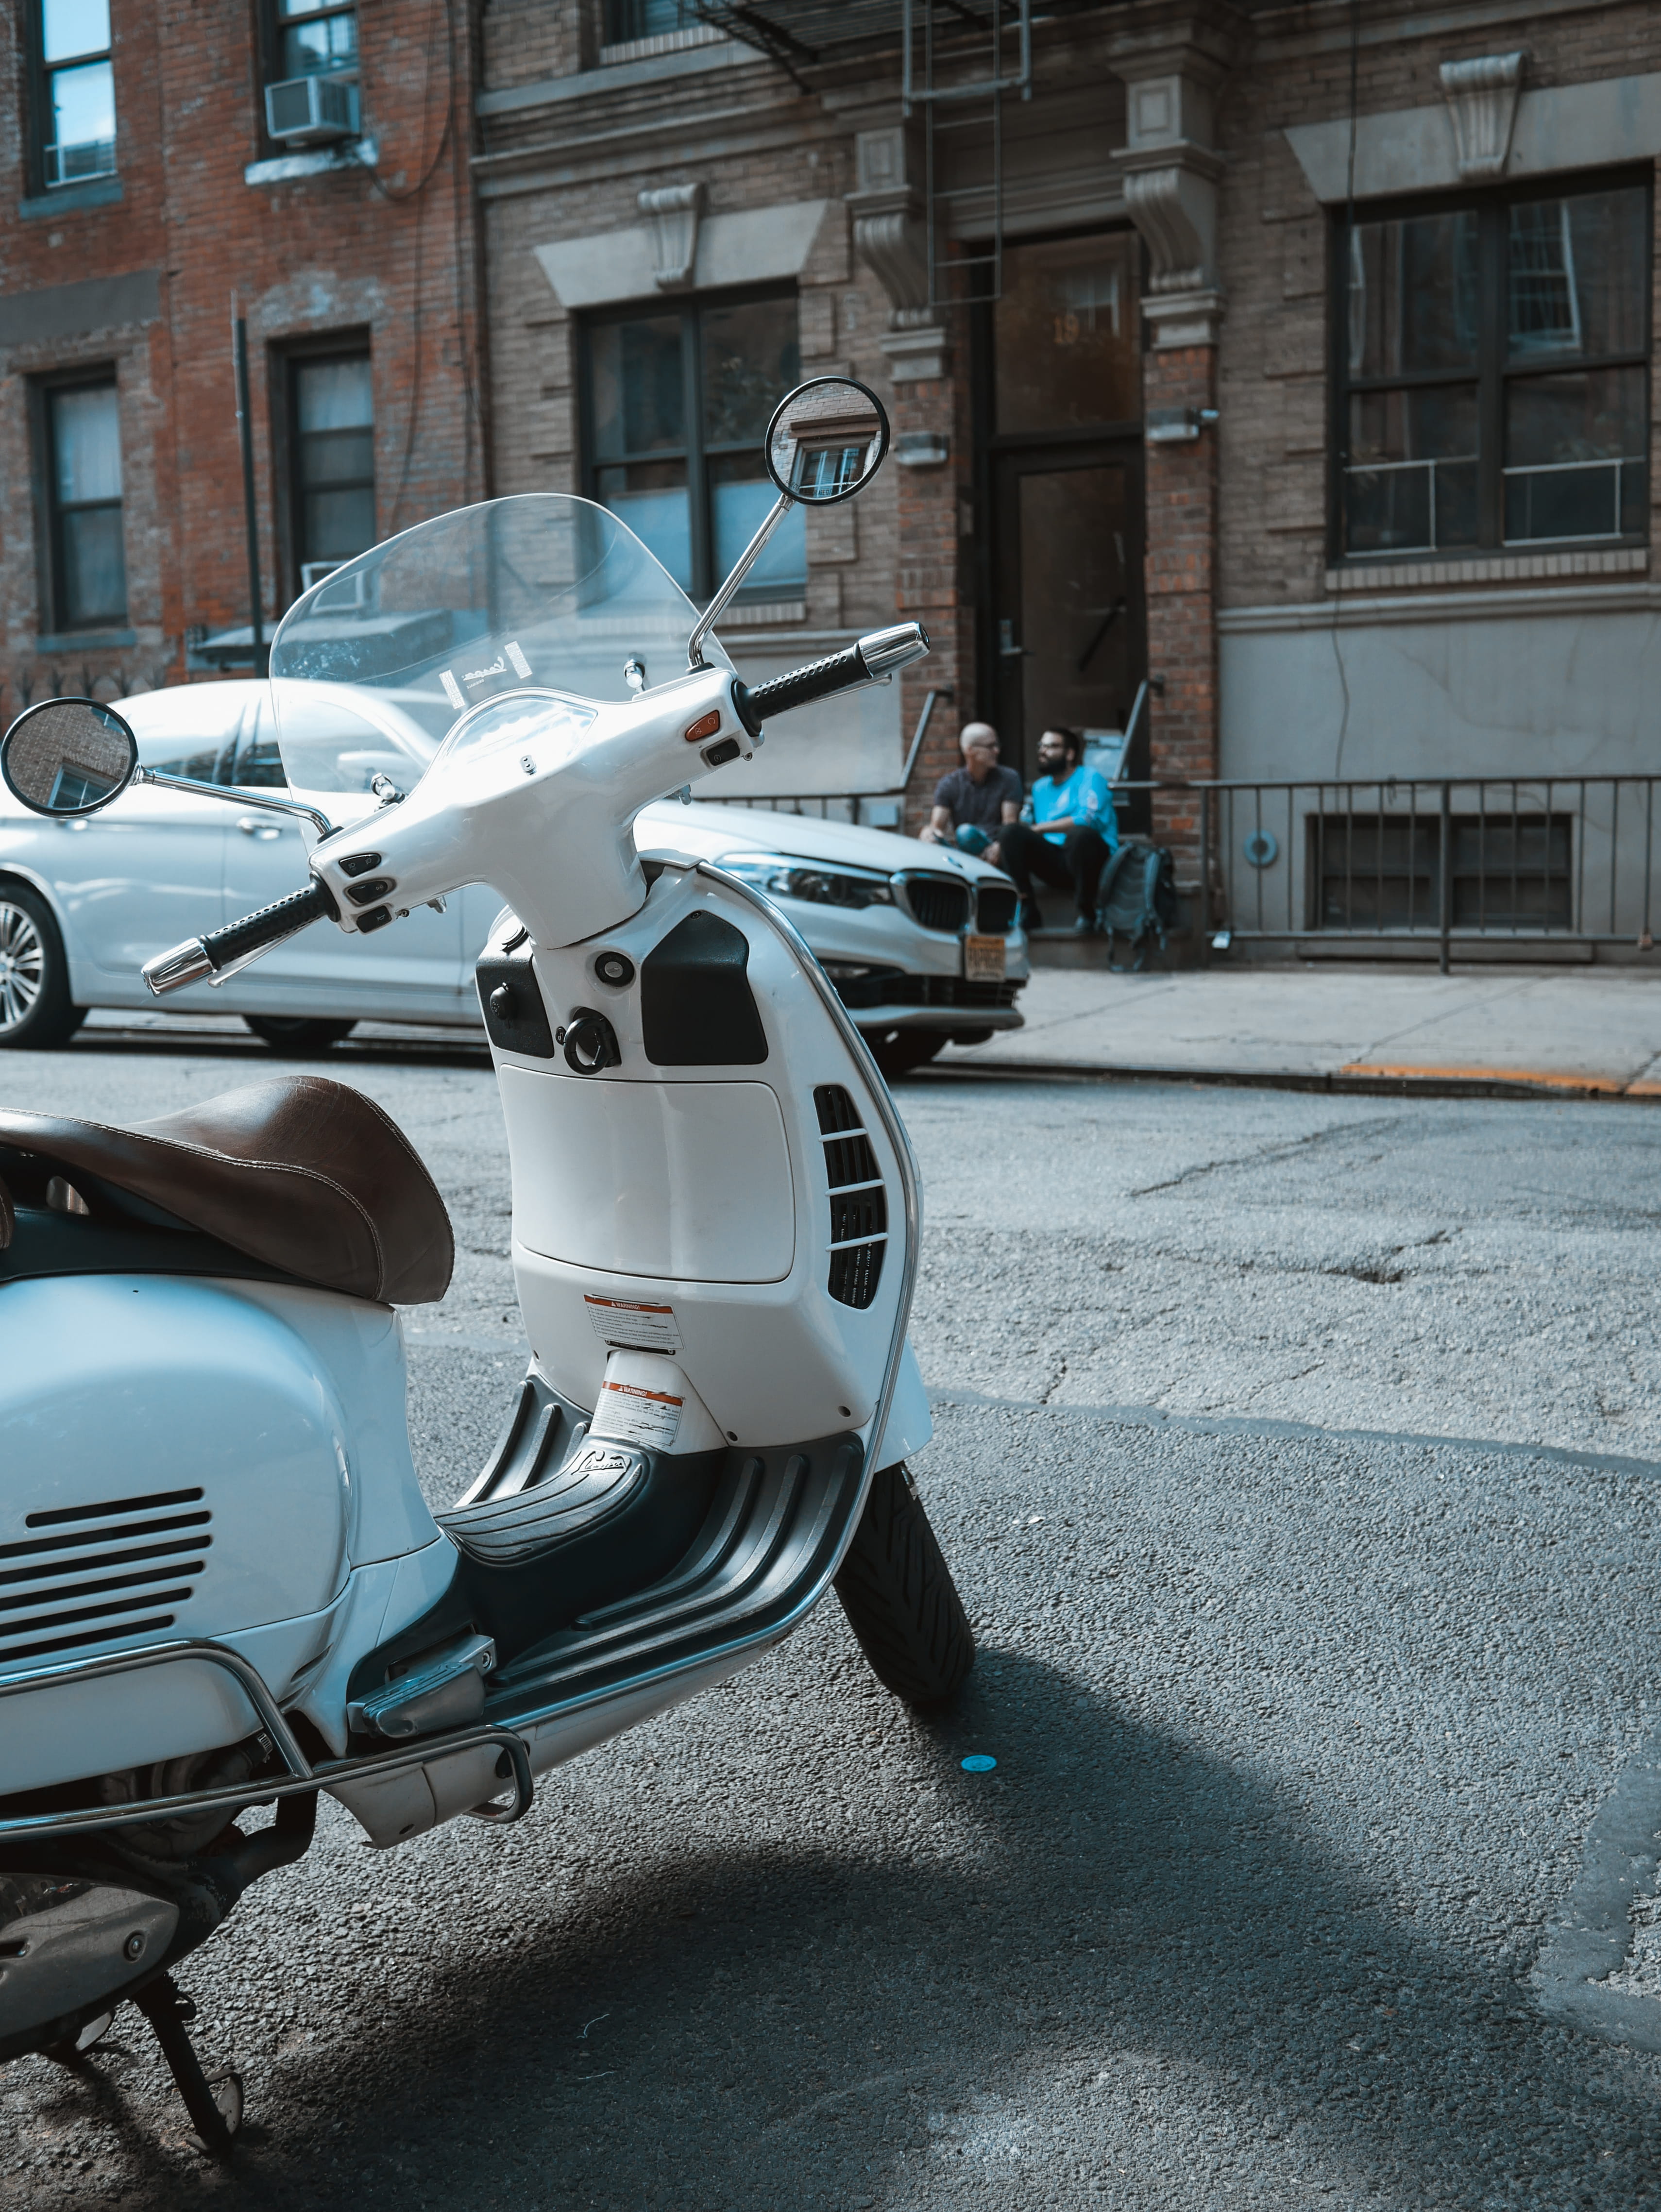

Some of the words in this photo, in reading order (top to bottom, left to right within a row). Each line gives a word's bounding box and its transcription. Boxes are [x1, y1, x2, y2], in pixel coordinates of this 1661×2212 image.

[1053, 315, 1080, 344] 19
[616, 1302, 641, 1310] WARNING!
[624, 1386, 647, 1397] WARNING!
